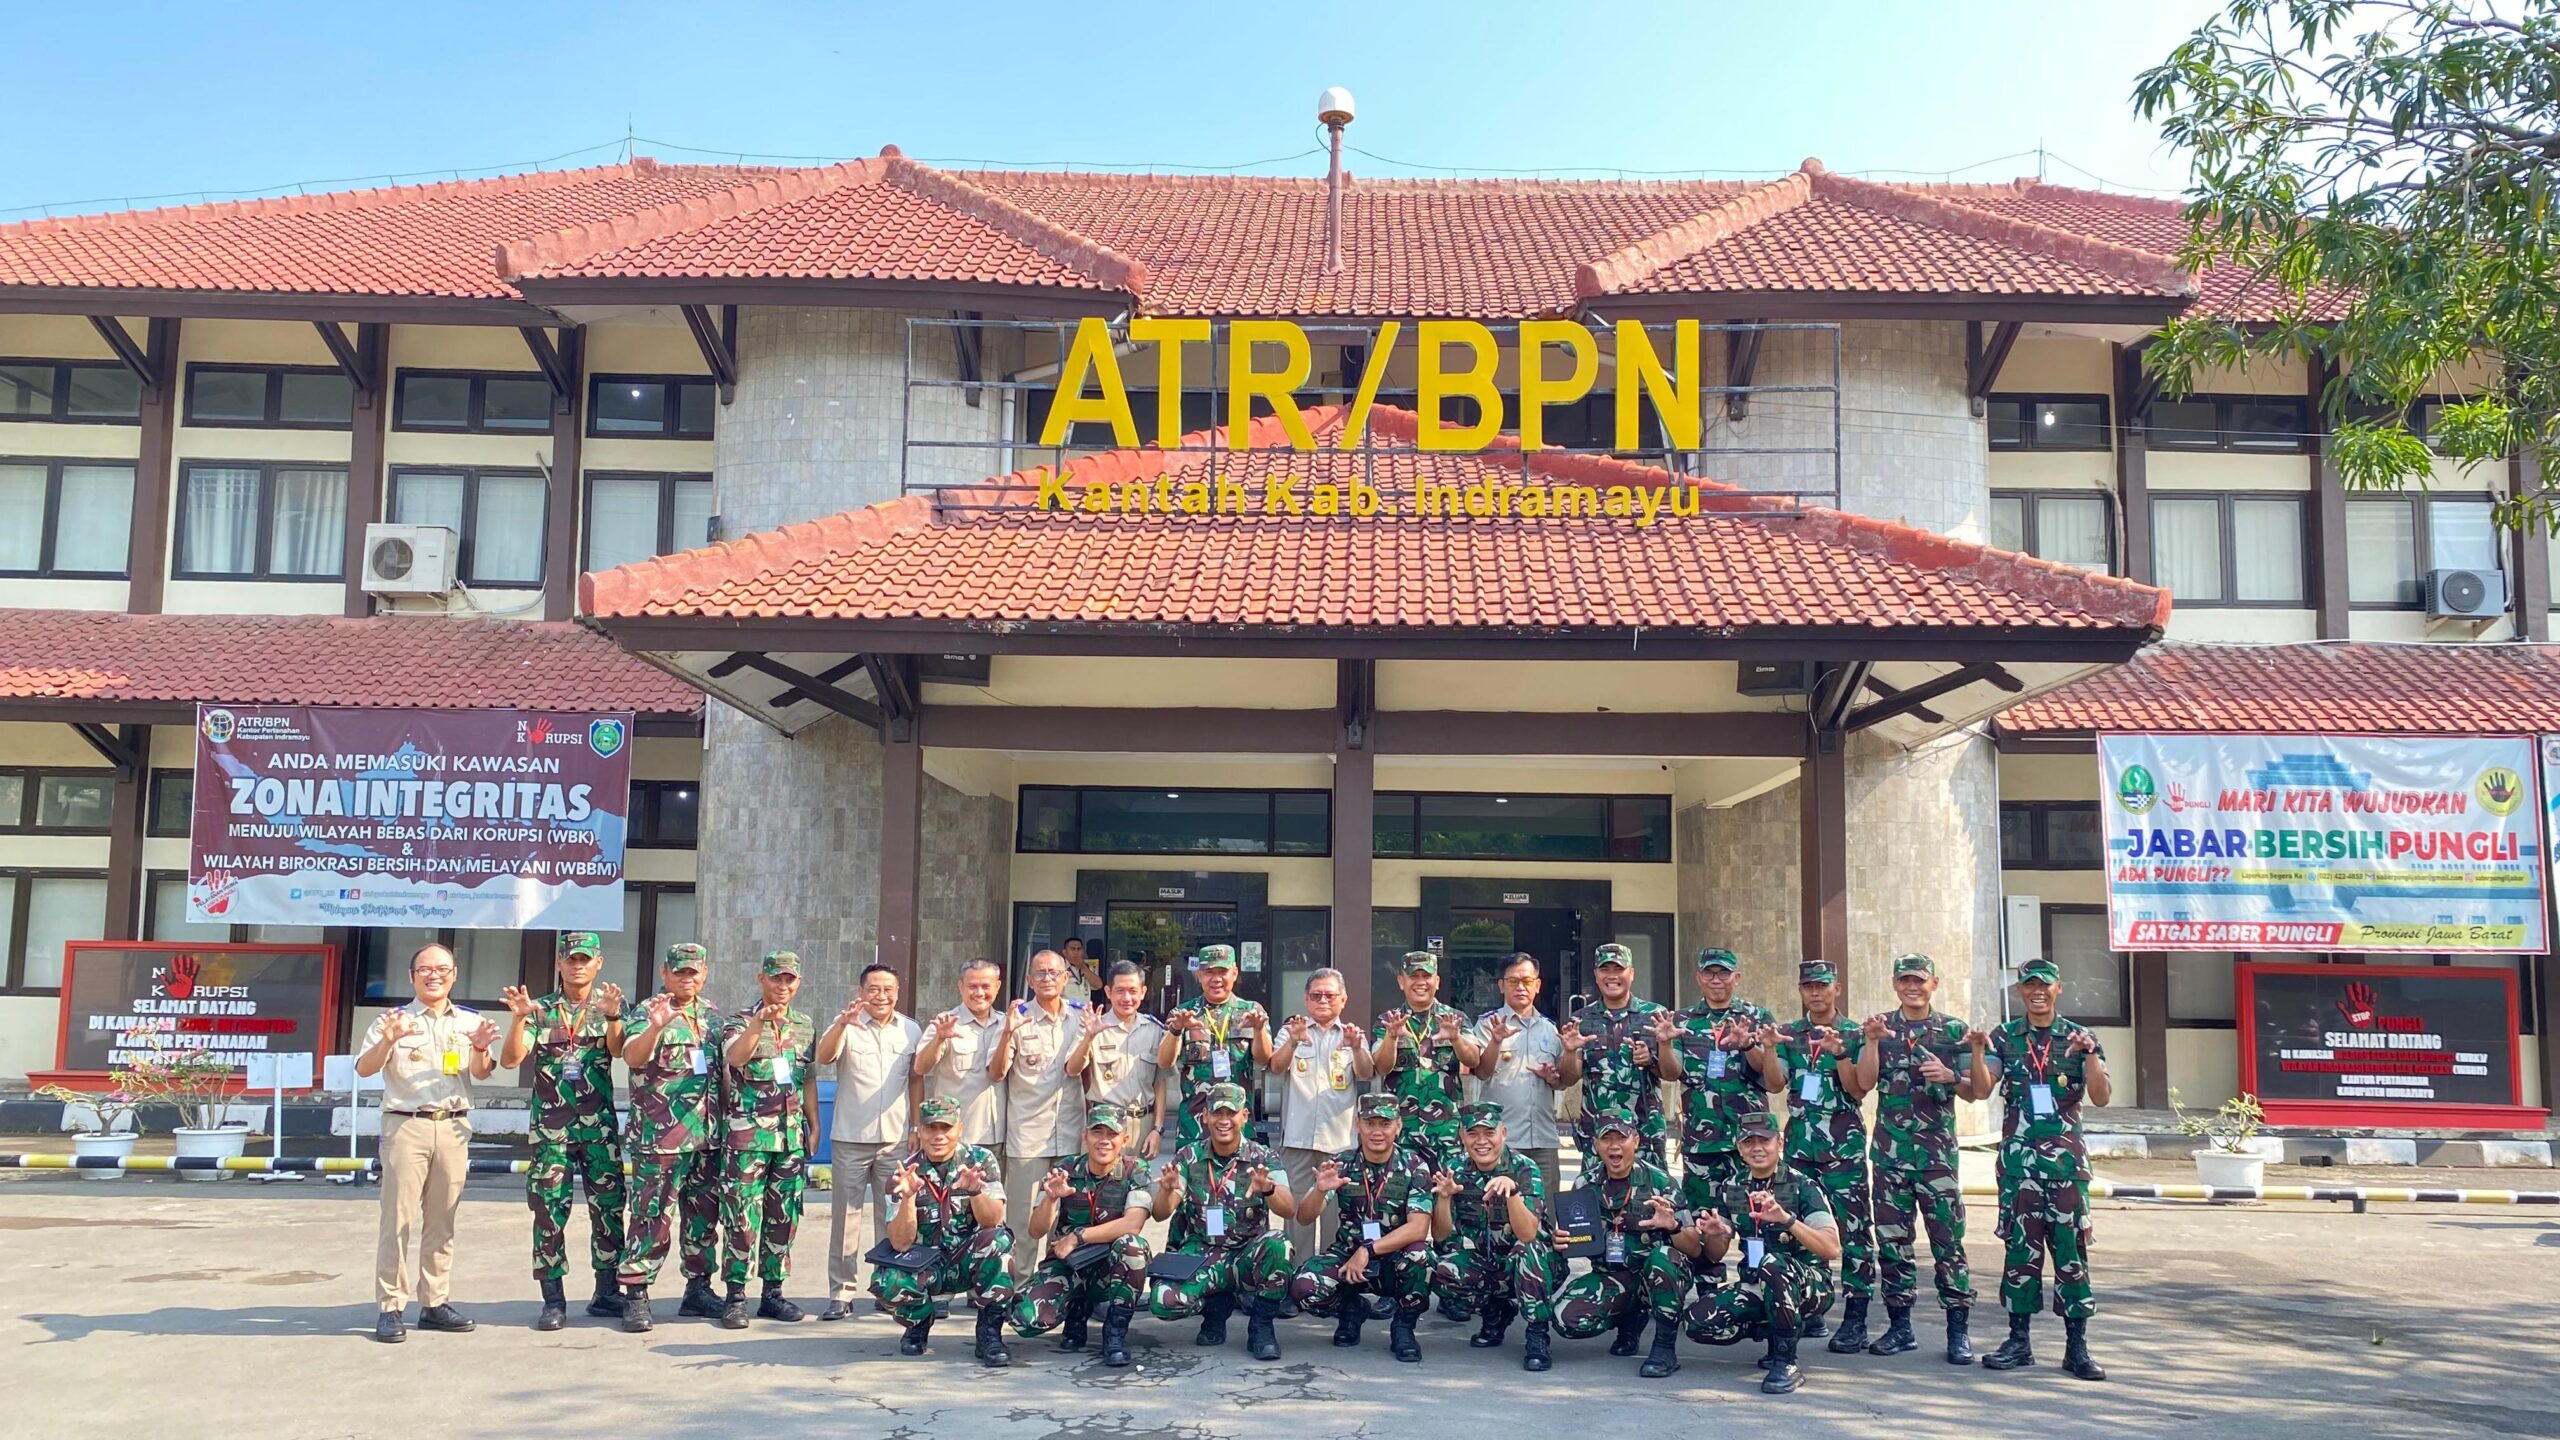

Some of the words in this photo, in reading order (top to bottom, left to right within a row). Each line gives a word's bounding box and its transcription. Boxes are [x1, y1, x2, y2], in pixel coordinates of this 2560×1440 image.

[1039, 317, 1700, 453] ATR/BPN
[1039, 470, 1245, 514] Kantah
[1266, 473, 1397, 517] Kab.
[1415, 474, 1700, 527] Indramayu
[238, 717, 290, 727] ATR/BPN
[236, 733, 274, 741] Kabupaten
[275, 734, 310, 742] Indramayu
[268, 753, 329, 770] ANDA
[335, 754, 445, 771] MEMASUKI
[453, 756, 560, 774] KAWASAN
[230, 777, 344, 816] ZONA
[354, 779, 593, 822] INTEGRITAS
[2218, 788, 2277, 813] MARI
[2283, 789, 2333, 814] KITA
[2342, 790, 2468, 816] WUJUDKAN
[228, 824, 295, 838] MENUJU
[299, 824, 372, 840] WILAYAH
[376, 826, 426, 840] BEBAS
[430, 826, 468, 841] DARI
[472, 828, 543, 843] KORUPSI
[547, 828, 596, 846] (WBK)
[2128, 828, 2248, 858] JABAR
[2254, 829, 2384, 860] BERSIH
[2389, 831, 2519, 861] PUNGLI
[402, 842, 414, 856] &
[203, 854, 274, 870] WILAYAH
[278, 856, 363, 871] BIROKRASI
[367, 857, 421, 872] BERSIH
[426, 858, 462, 873] DAN
[466, 859, 550, 875] MELAYANI
[555, 860, 618, 878] (WBBM)
[2118, 864, 2148, 882] ADA
[2154, 864, 2231, 883] PUNGLI??
[2136, 923, 2201, 942] SATGAS
[2205, 924, 2262, 942] SABER
[2266, 924, 2333, 942] PUNGLI
[2360, 924, 2421, 940] Provinsi
[2426, 926, 2464, 944] Jawa
[2468, 926, 2514, 940] Barat
[132, 998, 198, 1014] SELAMAT
[199, 1000, 257, 1016] DATANG
[2352, 1011, 2370, 1022] STOP
[88, 1015, 105, 1030] DI
[105, 1016, 176, 1031] KAWASAN
[174, 1034, 268, 1050] PERTANAHAN
[2324, 1031, 2387, 1048] SELAMAT
[2388, 1033, 2442, 1050] DATANG
